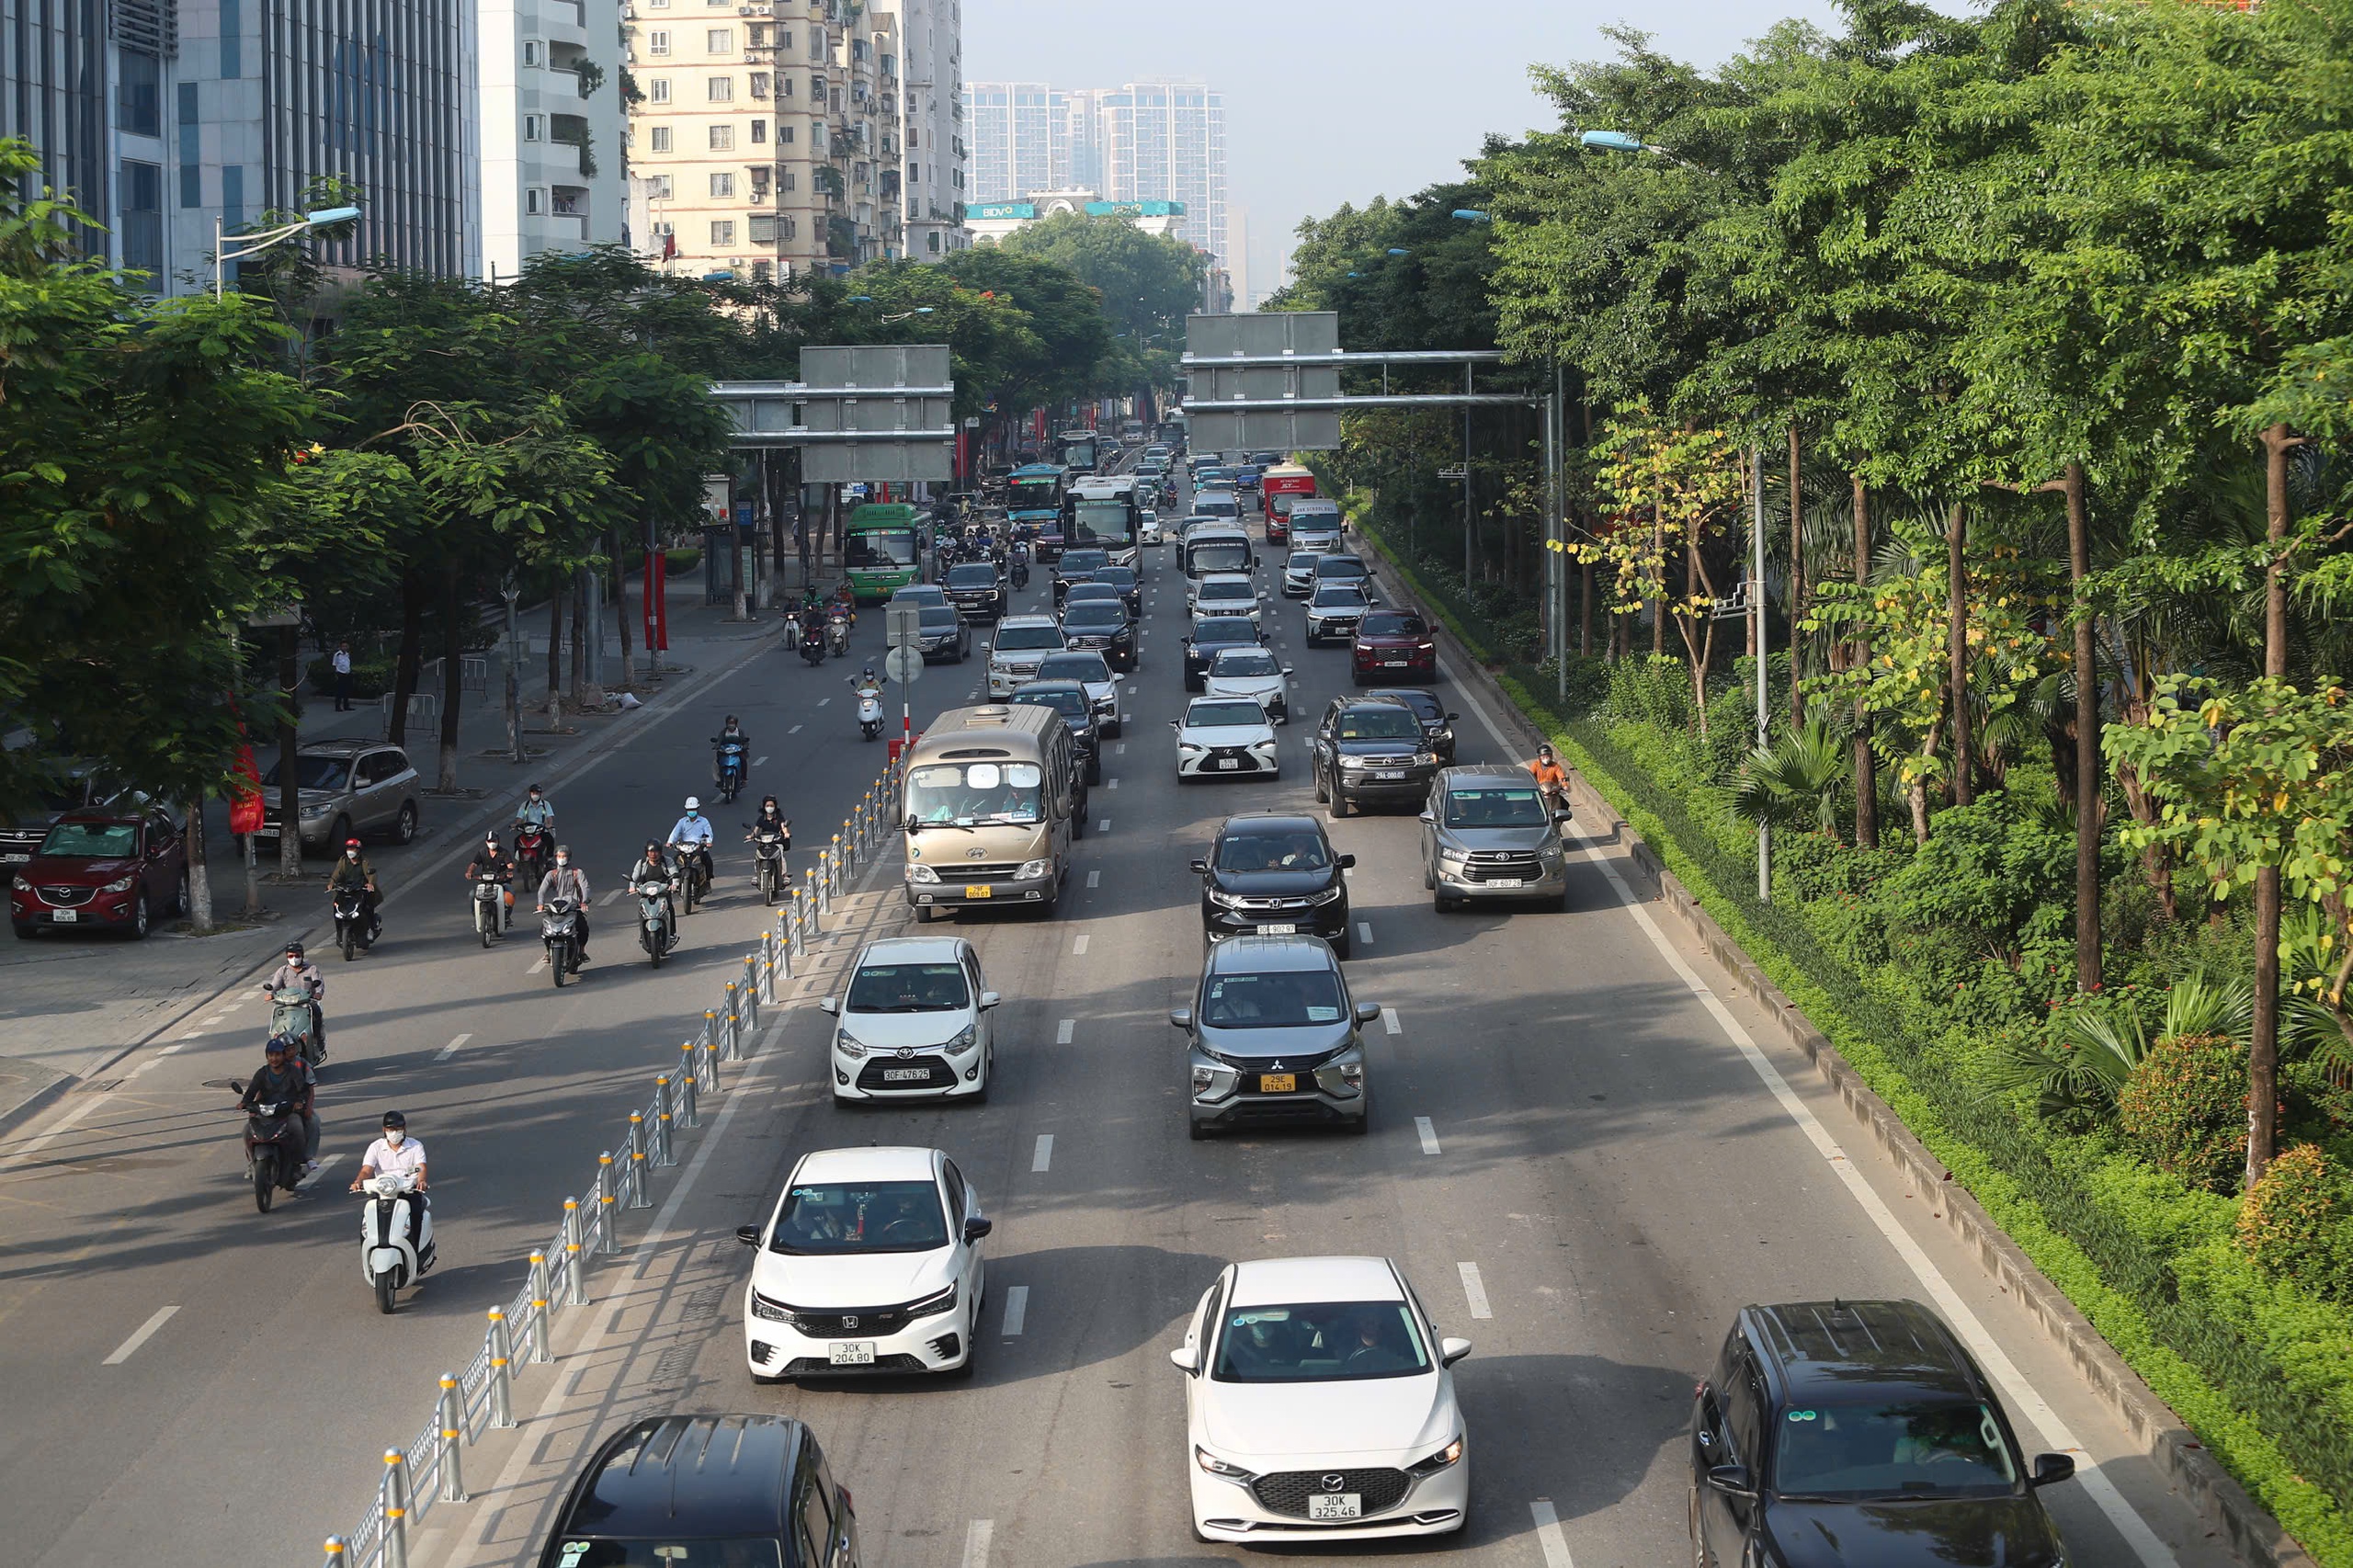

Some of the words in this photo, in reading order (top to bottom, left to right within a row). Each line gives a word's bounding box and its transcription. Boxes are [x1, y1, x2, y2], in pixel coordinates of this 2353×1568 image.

[983, 208, 1004, 217] BIDV
[1264, 1083, 1292, 1091] 014.19
[842, 1344, 861, 1353] 30K
[835, 1353, 870, 1363] 204.80
[1324, 1495, 1346, 1506] 30K
[1314, 1506, 1356, 1517] 325.46
